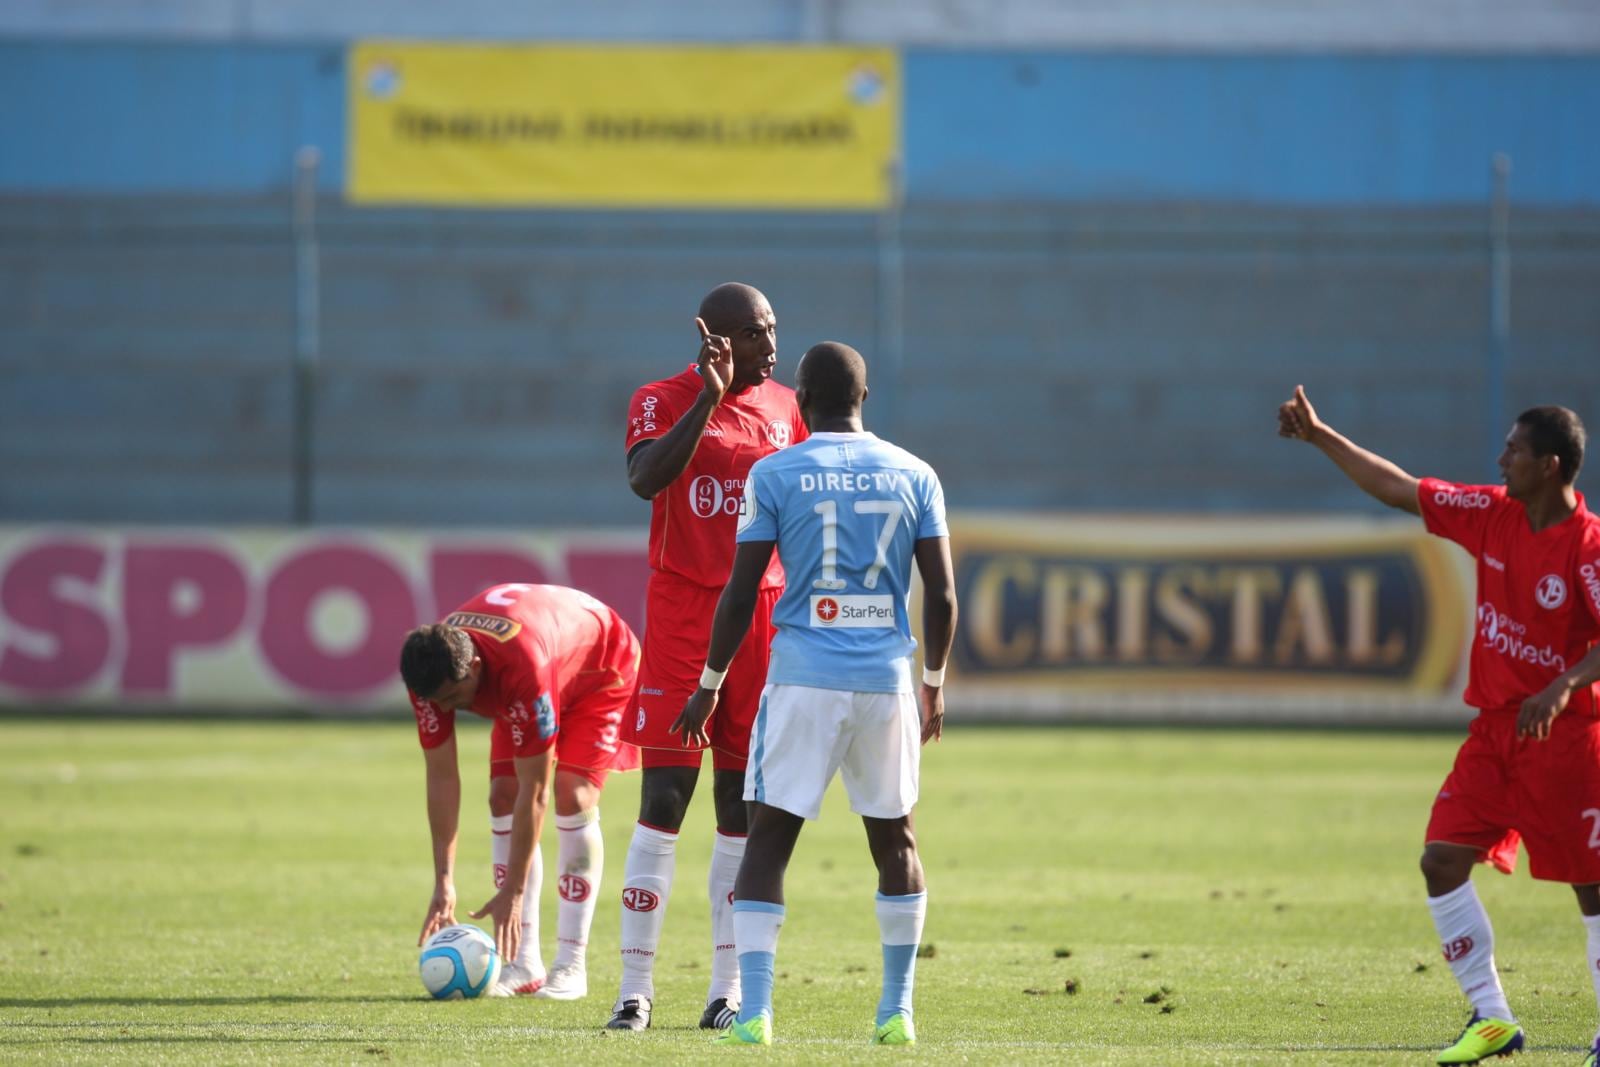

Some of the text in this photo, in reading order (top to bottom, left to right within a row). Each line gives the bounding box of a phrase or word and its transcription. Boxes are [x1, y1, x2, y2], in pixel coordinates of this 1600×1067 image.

[724, 479, 747, 492] gru
[801, 472, 900, 493] DIRECTV
[1434, 489, 1491, 508] oviedo
[812, 500, 904, 590] 17
[966, 556, 1408, 668] CRISTAL
[452, 615, 510, 634] CRISTAL
